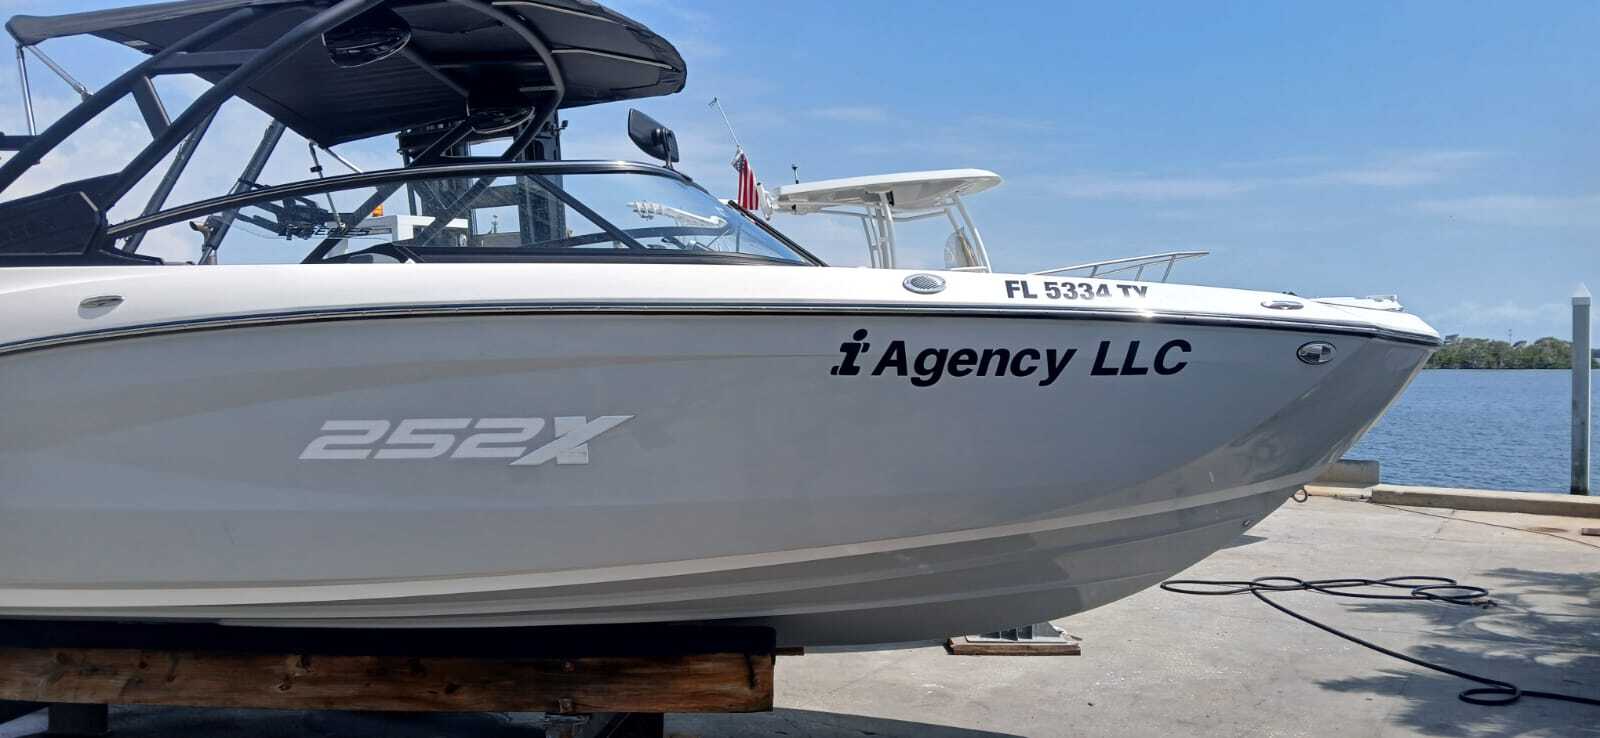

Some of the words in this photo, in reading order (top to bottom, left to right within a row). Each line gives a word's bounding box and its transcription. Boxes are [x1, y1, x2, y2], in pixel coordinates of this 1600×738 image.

[1005, 280, 1038, 299] FL
[1044, 281, 1112, 300] 5334
[871, 340, 1077, 387] Agency
[1090, 339, 1192, 376] LLC
[298, 415, 635, 466] 252X
